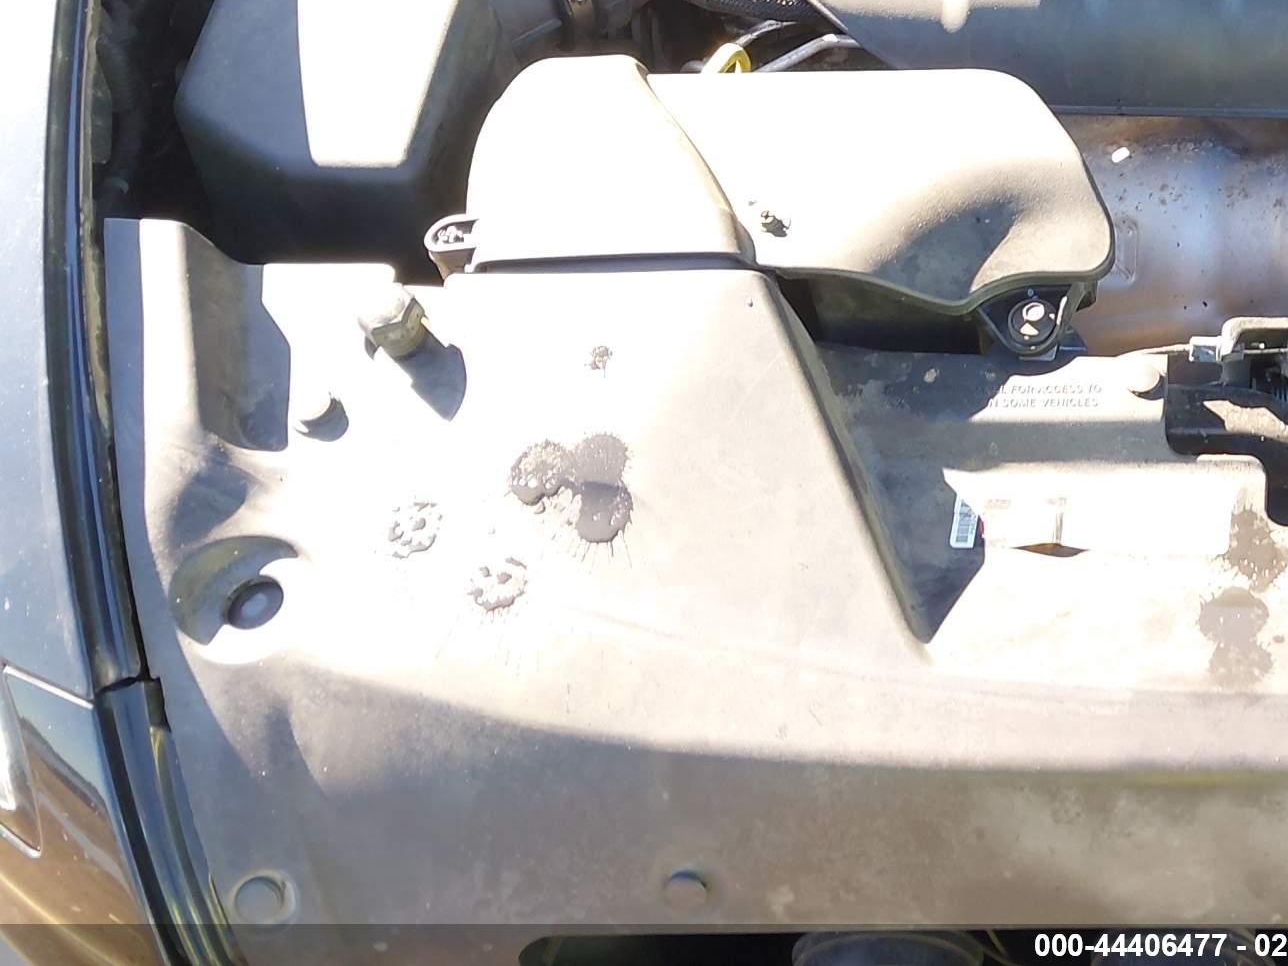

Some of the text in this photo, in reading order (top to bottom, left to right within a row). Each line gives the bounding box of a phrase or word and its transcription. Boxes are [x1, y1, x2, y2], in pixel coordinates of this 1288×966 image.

[1010, 384, 1035, 394] FOR
[1037, 384, 1083, 394] ACCESS
[1088, 384, 1103, 394] TO
[1003, 397, 1037, 408] SOME
[1043, 397, 1099, 408] VEHICLES
